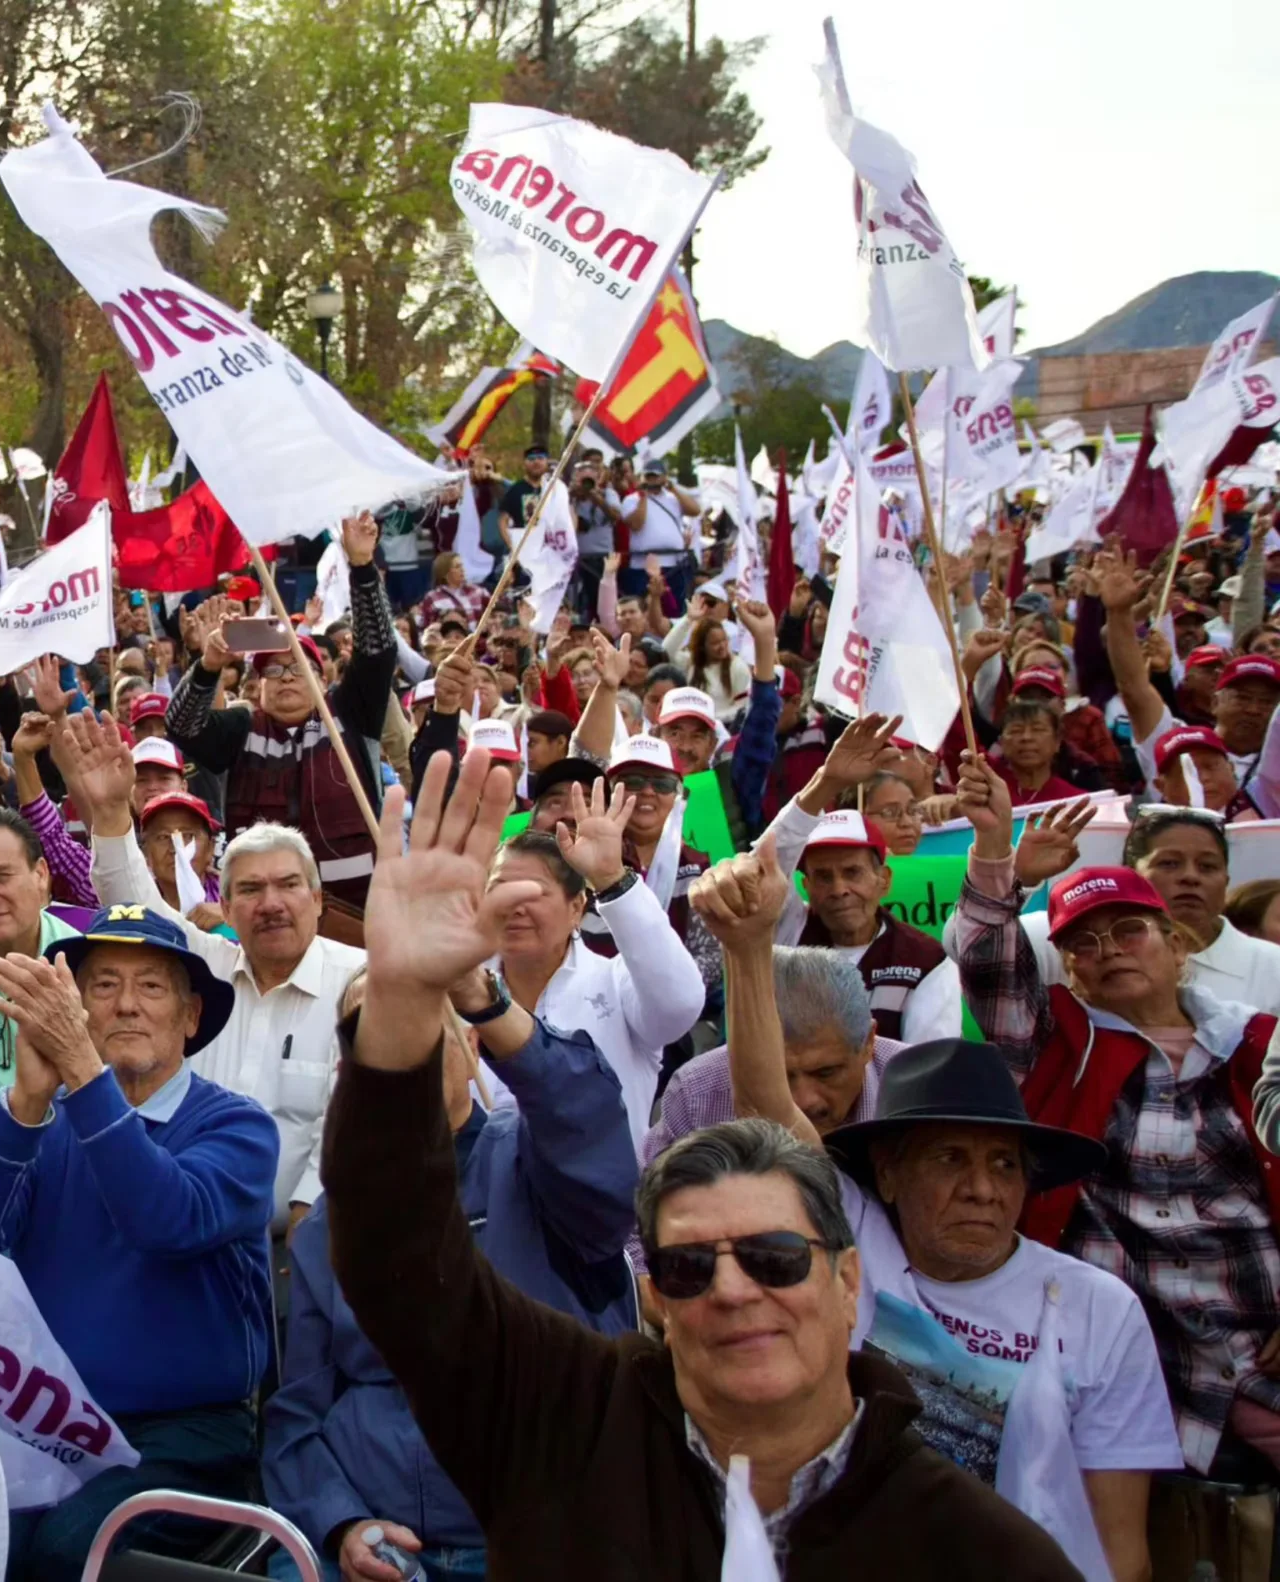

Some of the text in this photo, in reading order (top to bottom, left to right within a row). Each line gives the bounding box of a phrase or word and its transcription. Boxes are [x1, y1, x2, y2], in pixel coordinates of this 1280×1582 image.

[220, 347, 253, 378] de
[1063, 877, 1117, 902] morena
[108, 904, 146, 920] M
[871, 965, 922, 979] morena
